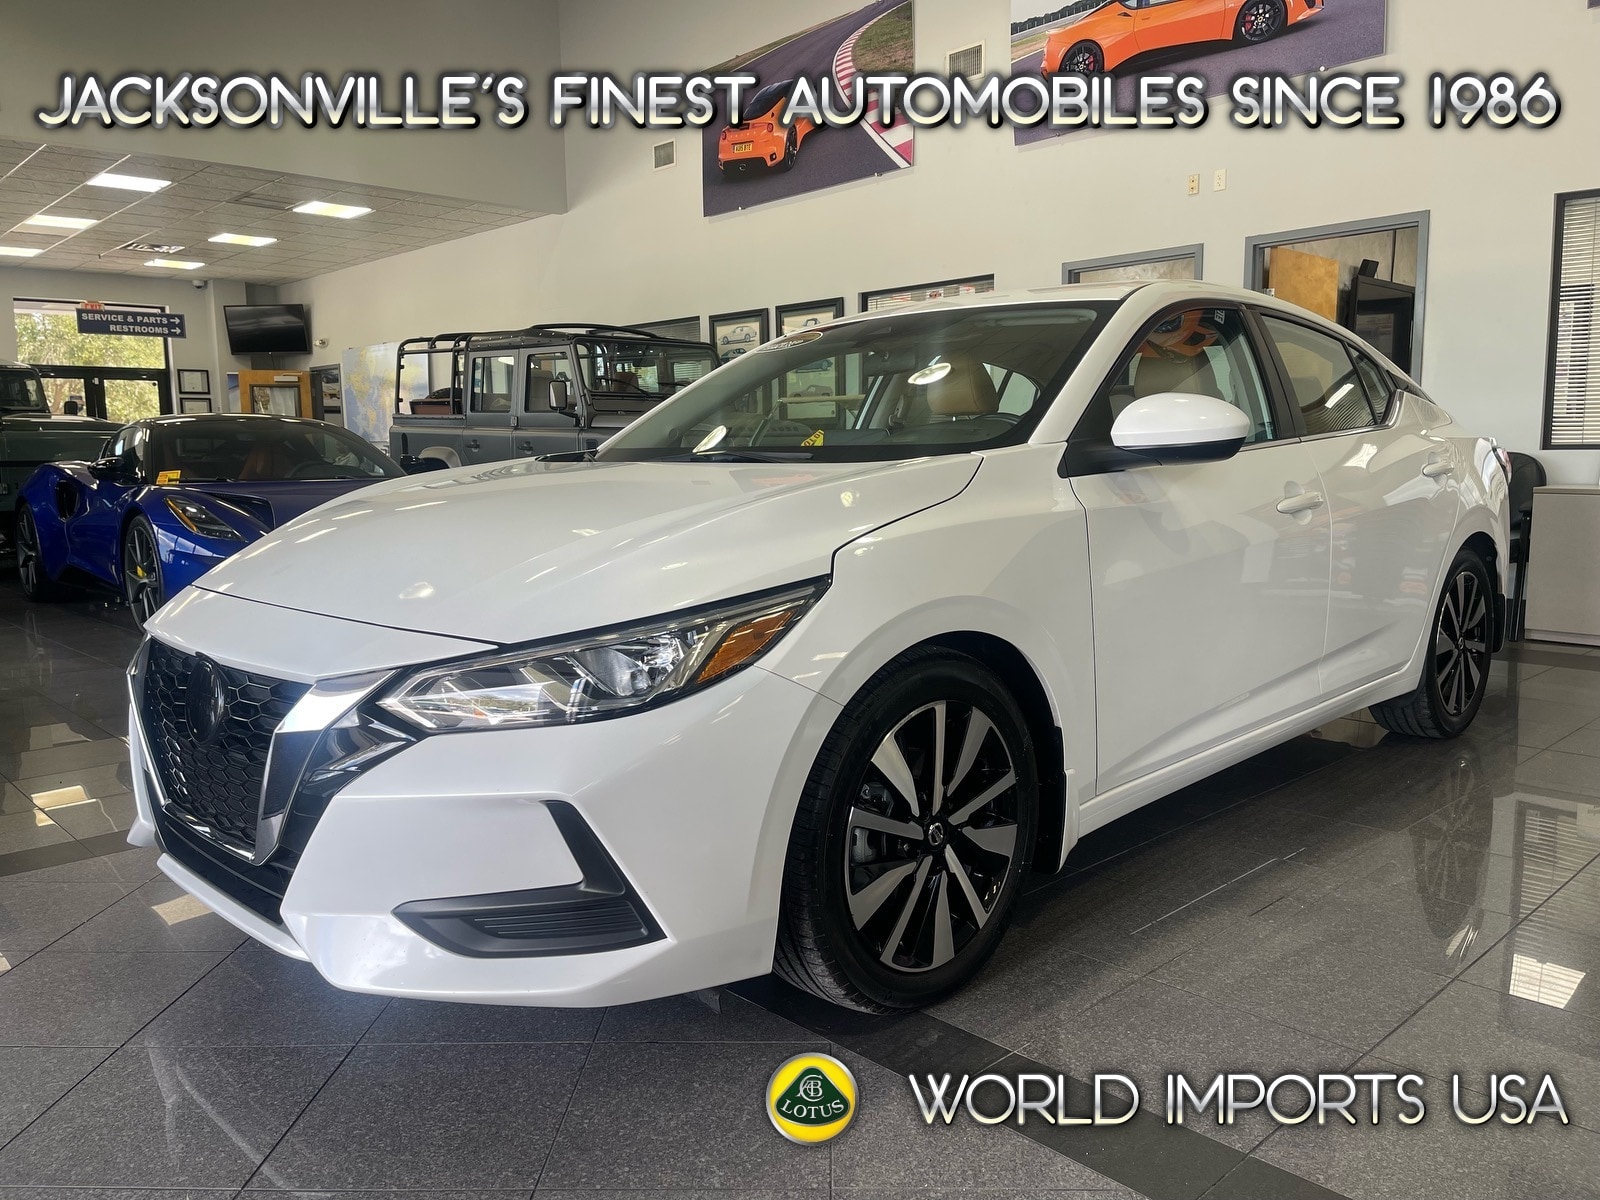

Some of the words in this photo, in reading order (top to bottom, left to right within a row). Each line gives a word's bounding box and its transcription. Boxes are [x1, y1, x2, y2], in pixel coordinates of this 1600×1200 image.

[81, 313, 124, 322] SERVICE
[137, 316, 168, 324] PARTS
[109, 324, 169, 334] RESTROOMS
